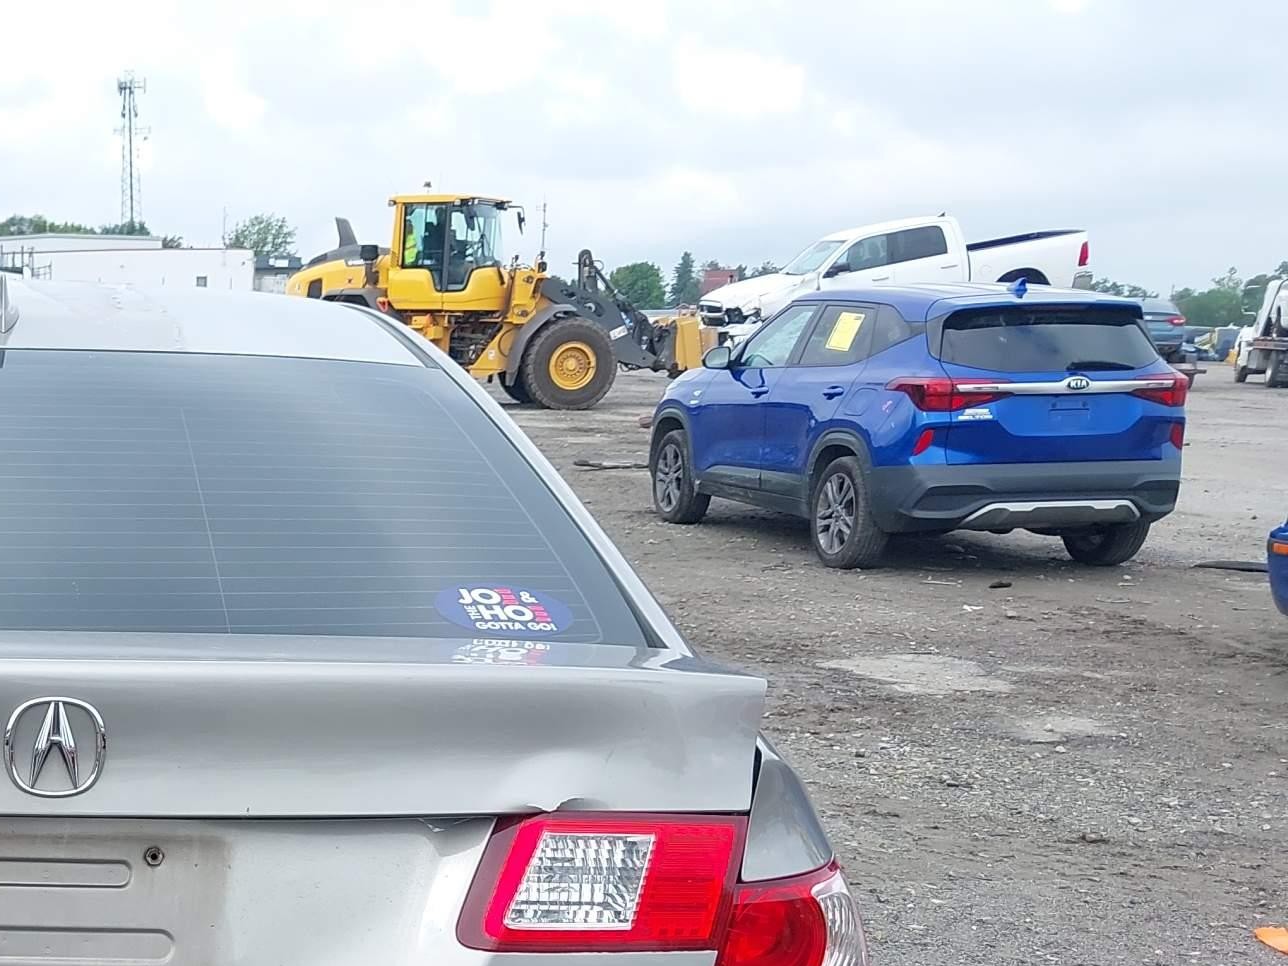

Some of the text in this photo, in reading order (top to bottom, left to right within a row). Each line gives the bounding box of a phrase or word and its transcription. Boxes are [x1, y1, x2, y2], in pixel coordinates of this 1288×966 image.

[1070, 380, 1087, 389] KIA
[519, 591, 538, 603] &
[464, 605, 482, 620] THE
[475, 621, 558, 631] GOTTA GO!
